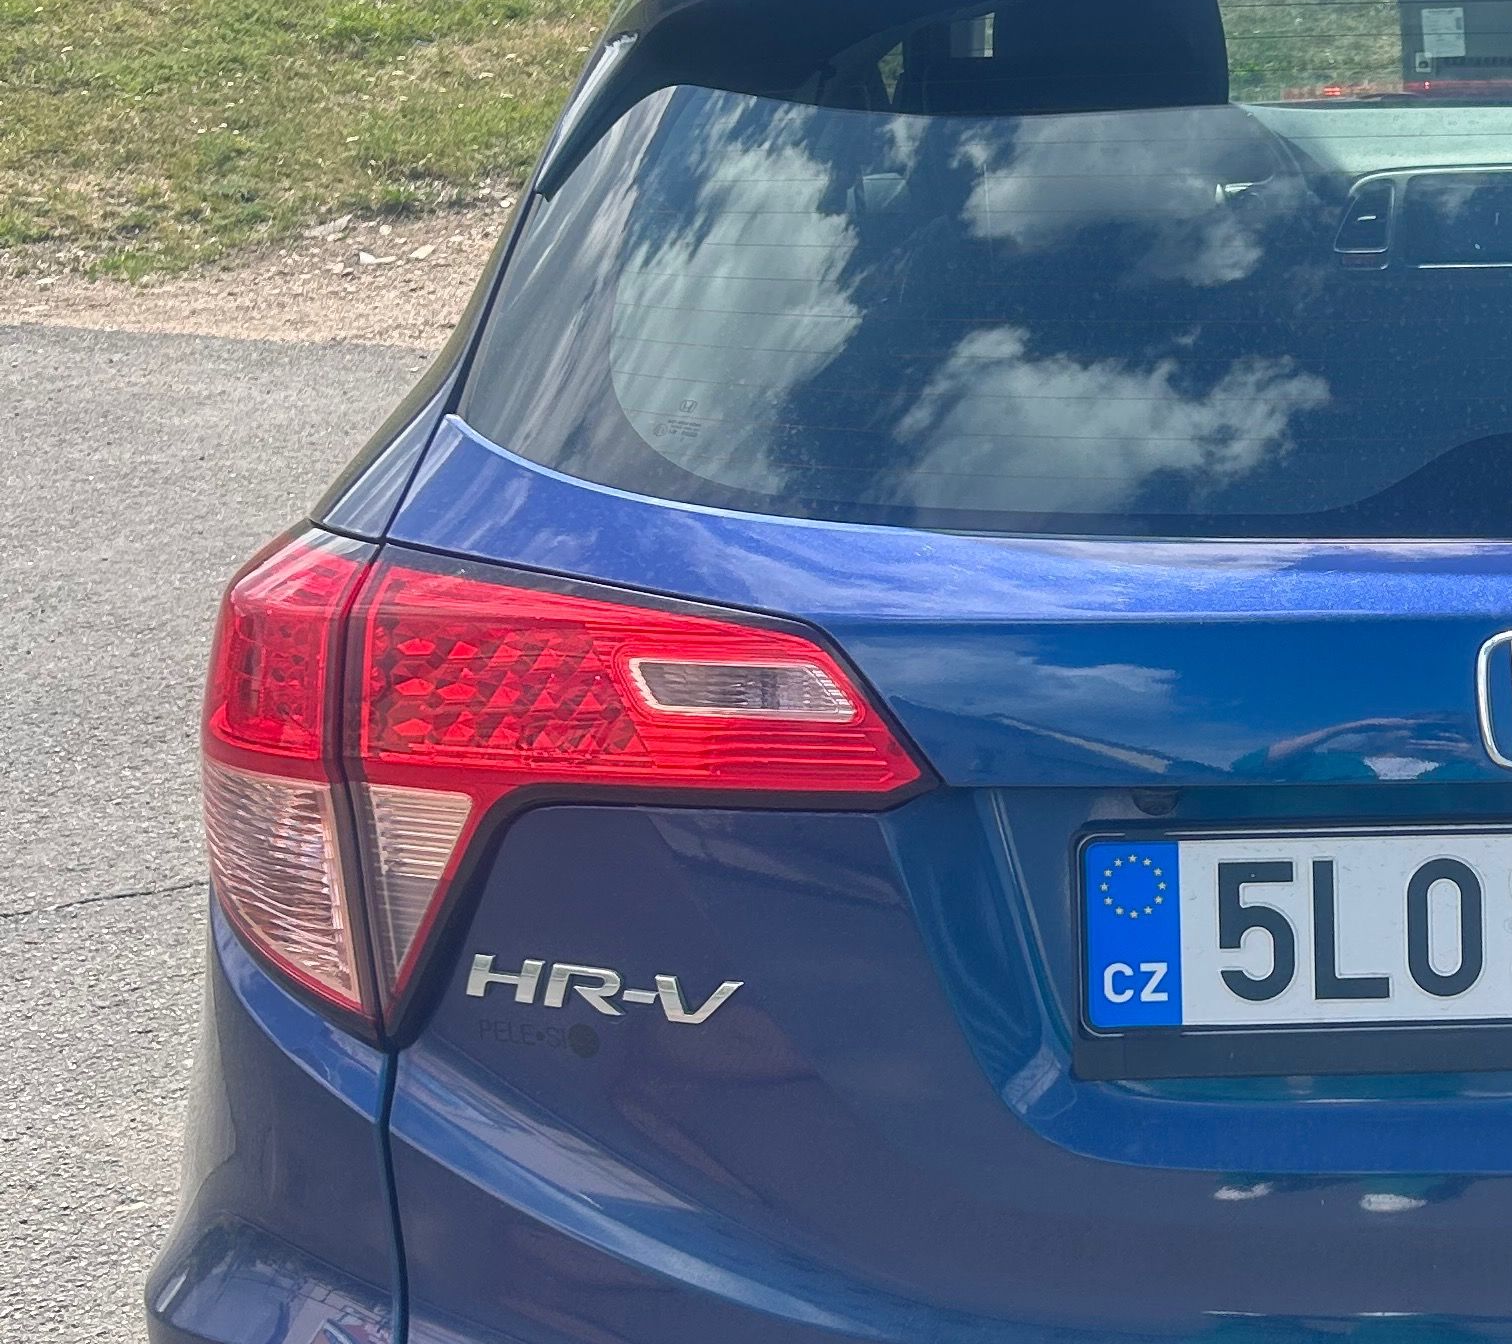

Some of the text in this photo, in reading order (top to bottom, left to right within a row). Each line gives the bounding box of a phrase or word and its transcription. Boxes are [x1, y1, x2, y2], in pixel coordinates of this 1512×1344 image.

[1216, 857, 1484, 1002] 5L0
[465, 953, 745, 1025] HR-V
[1103, 962, 1169, 1003] CZ
